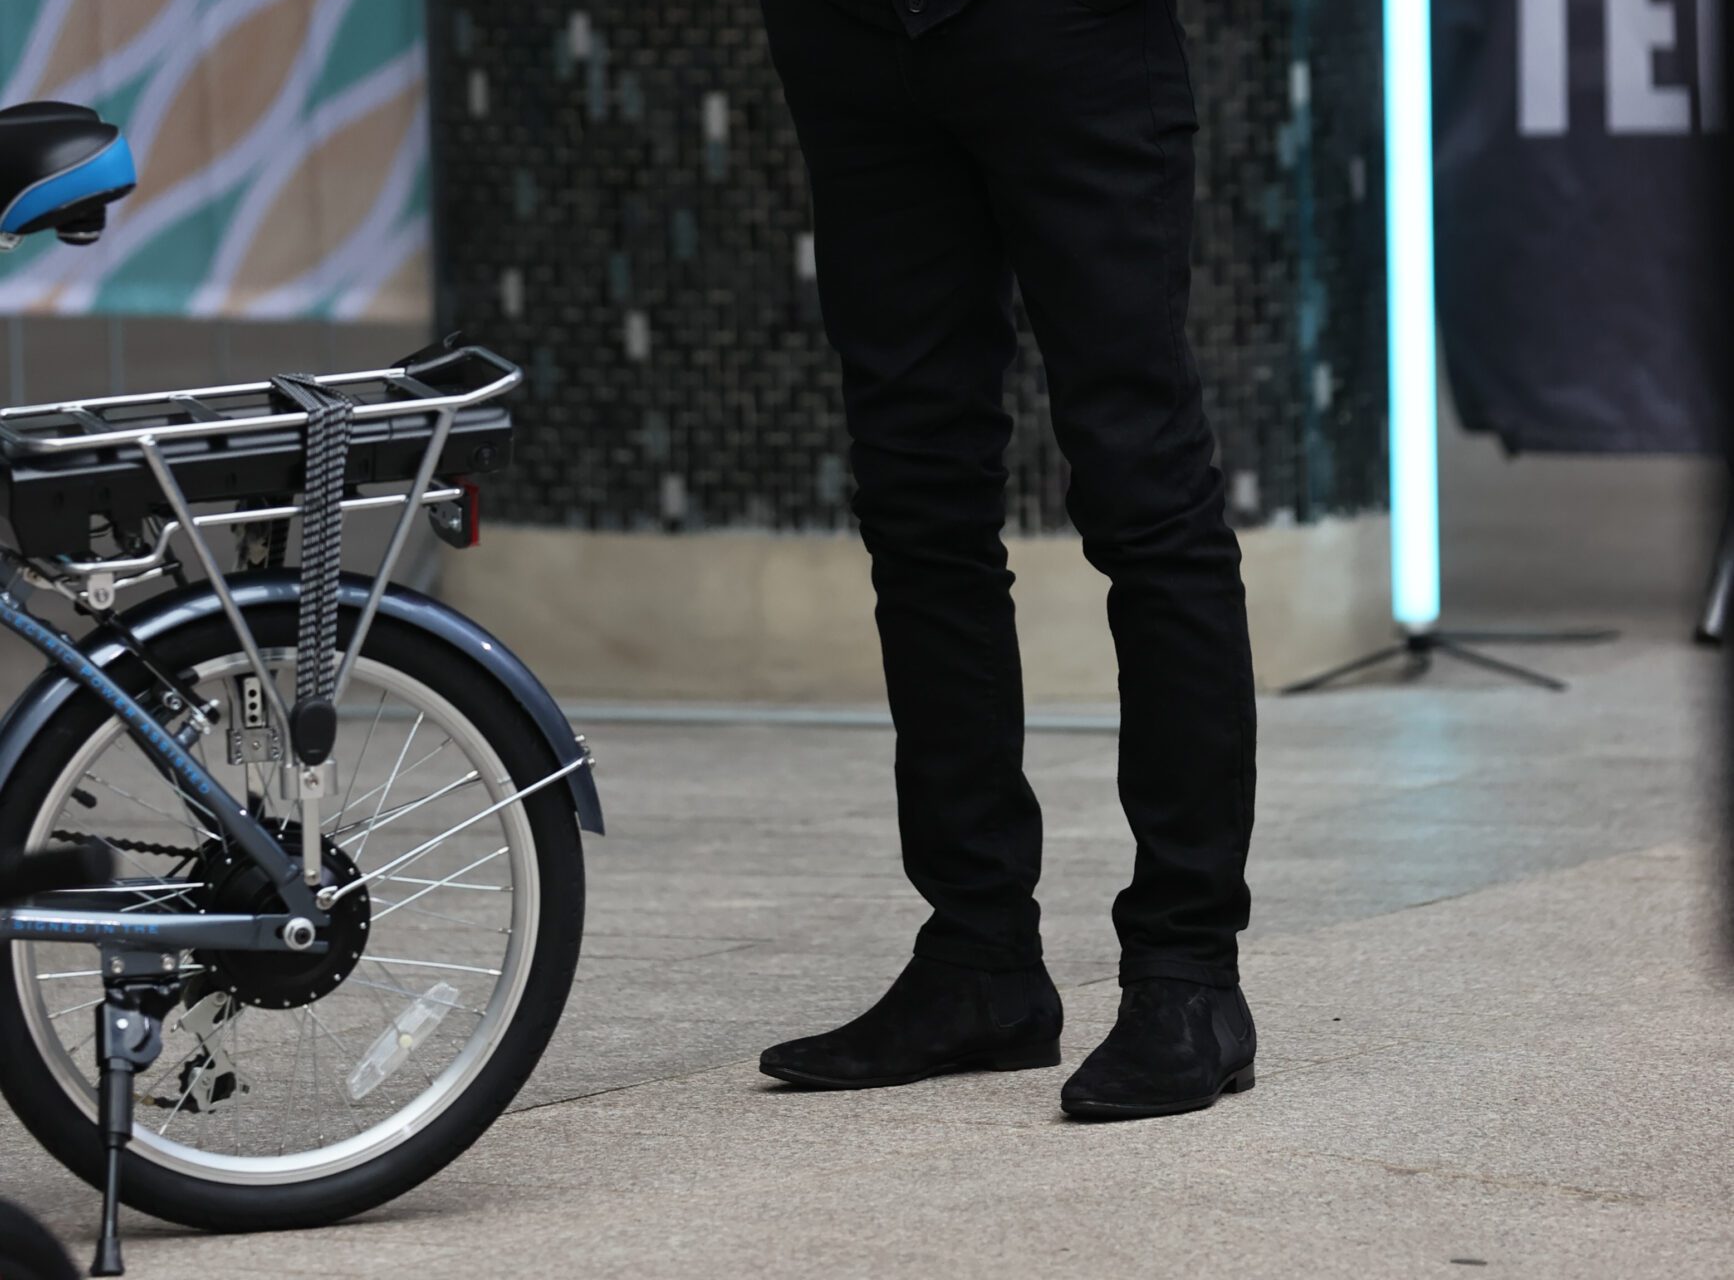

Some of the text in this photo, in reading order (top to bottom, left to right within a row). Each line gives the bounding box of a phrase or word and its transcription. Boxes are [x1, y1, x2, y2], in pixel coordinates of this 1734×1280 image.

[80, 664, 136, 718] POWER
[139, 721, 210, 795] ASSISTED
[95, 923, 115, 934] IN
[122, 923, 159, 935] THE
